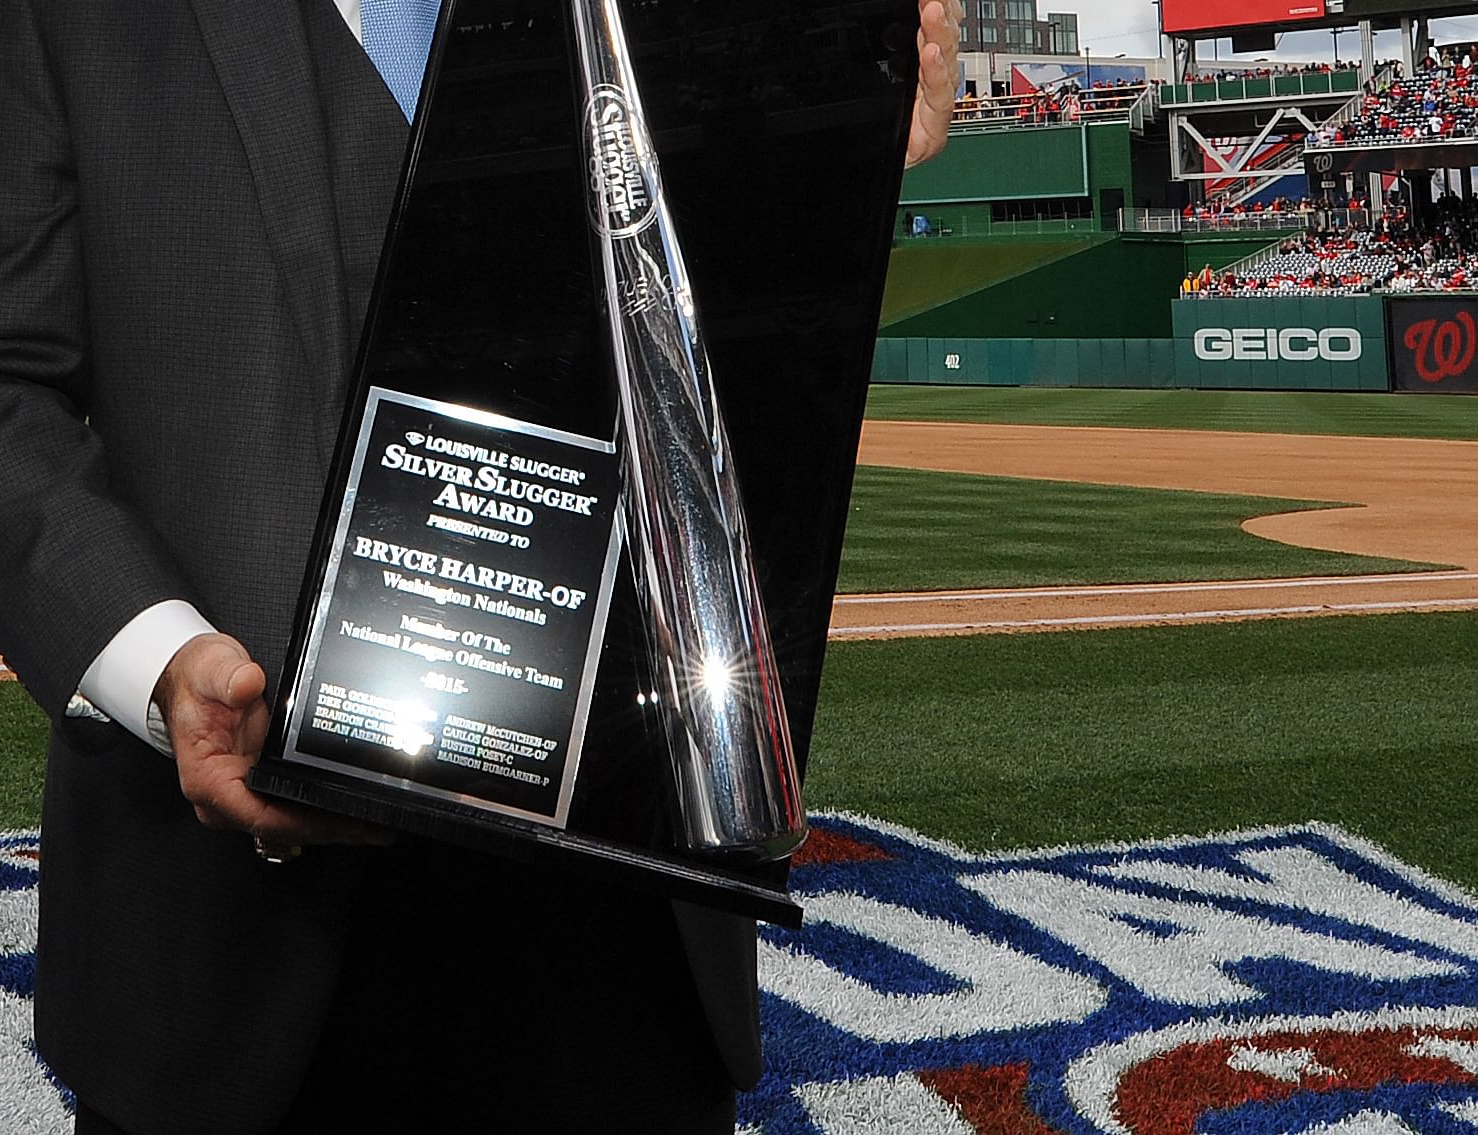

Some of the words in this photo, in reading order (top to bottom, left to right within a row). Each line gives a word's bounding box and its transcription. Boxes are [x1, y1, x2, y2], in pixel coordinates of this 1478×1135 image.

[945, 354, 960, 369] 402
[1194, 327, 1362, 361] GEICO
[1404, 311, 1476, 383] W
[381, 444, 473, 487] SILVER
[425, 435, 508, 468] LOUISVILLE
[433, 483, 534, 526] AWARD
[426, 514, 510, 544] PRESENTED
[511, 534, 530, 549] TO
[353, 536, 437, 575] BRYCE
[438, 557, 586, 610] HARPER-OF
[383, 570, 471, 607] Washington
[472, 593, 547, 626] Nationals
[399, 615, 461, 643] Member
[461, 630, 484, 647] Of
[484, 636, 511, 656] The
[339, 620, 401, 649] National
[401, 635, 454, 663] League
[455, 650, 523, 680] Offensive
[525, 665, 564, 690] Team
[319, 683, 347, 700] PAUL
[312, 717, 350, 736] NOLAN
[315, 705, 364, 727] BRANDON
[445, 714, 486, 734] ANDREW
[441, 737, 476, 756] BUSTER
[477, 746, 514, 766] POSEY-C
[442, 726, 482, 745] CARLOS
[482, 736, 549, 761] GONZALEZ-OF
[437, 750, 481, 770] MADISON
[482, 761, 550, 786] BUMGARNER-P
